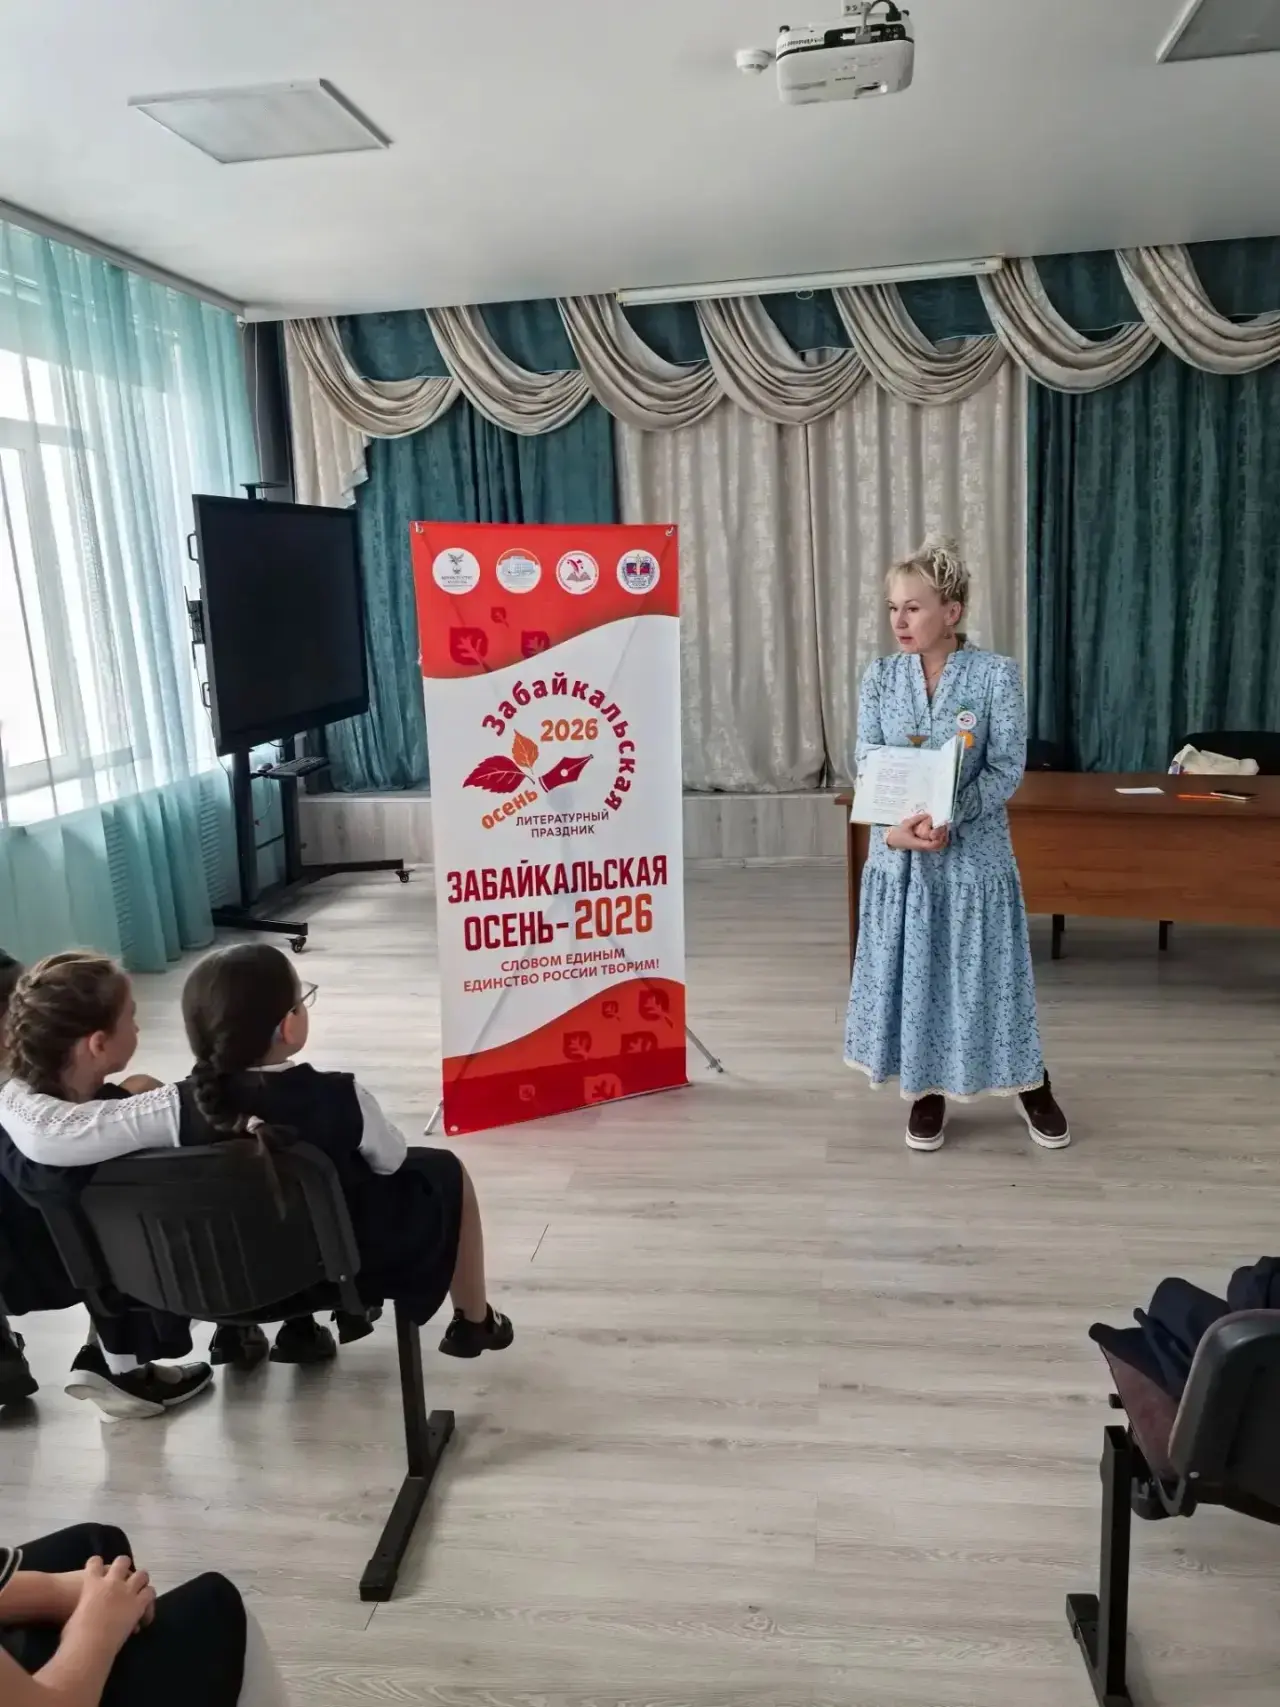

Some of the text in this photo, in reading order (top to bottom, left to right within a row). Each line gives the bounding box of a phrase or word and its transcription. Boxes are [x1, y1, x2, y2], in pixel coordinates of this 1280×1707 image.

[482, 672, 635, 811] Забайкальская
[540, 718, 599, 742] 2026
[481, 789, 538, 830] осень
[516, 809, 609, 826] ЛИТЕРАТУРНЫЙ
[531, 824, 595, 839] ПРАЗДНИК
[447, 855, 668, 904] ЗАБАЙКАЛЬСКАЯ
[464, 893, 653, 951] ОСЕНЬ-2026
[463, 959, 660, 992] ЕДИНСТВО РОССИИ ТВОРИМ!
[501, 948, 625, 973] СЛОВОМ ЕДИНЫМ
